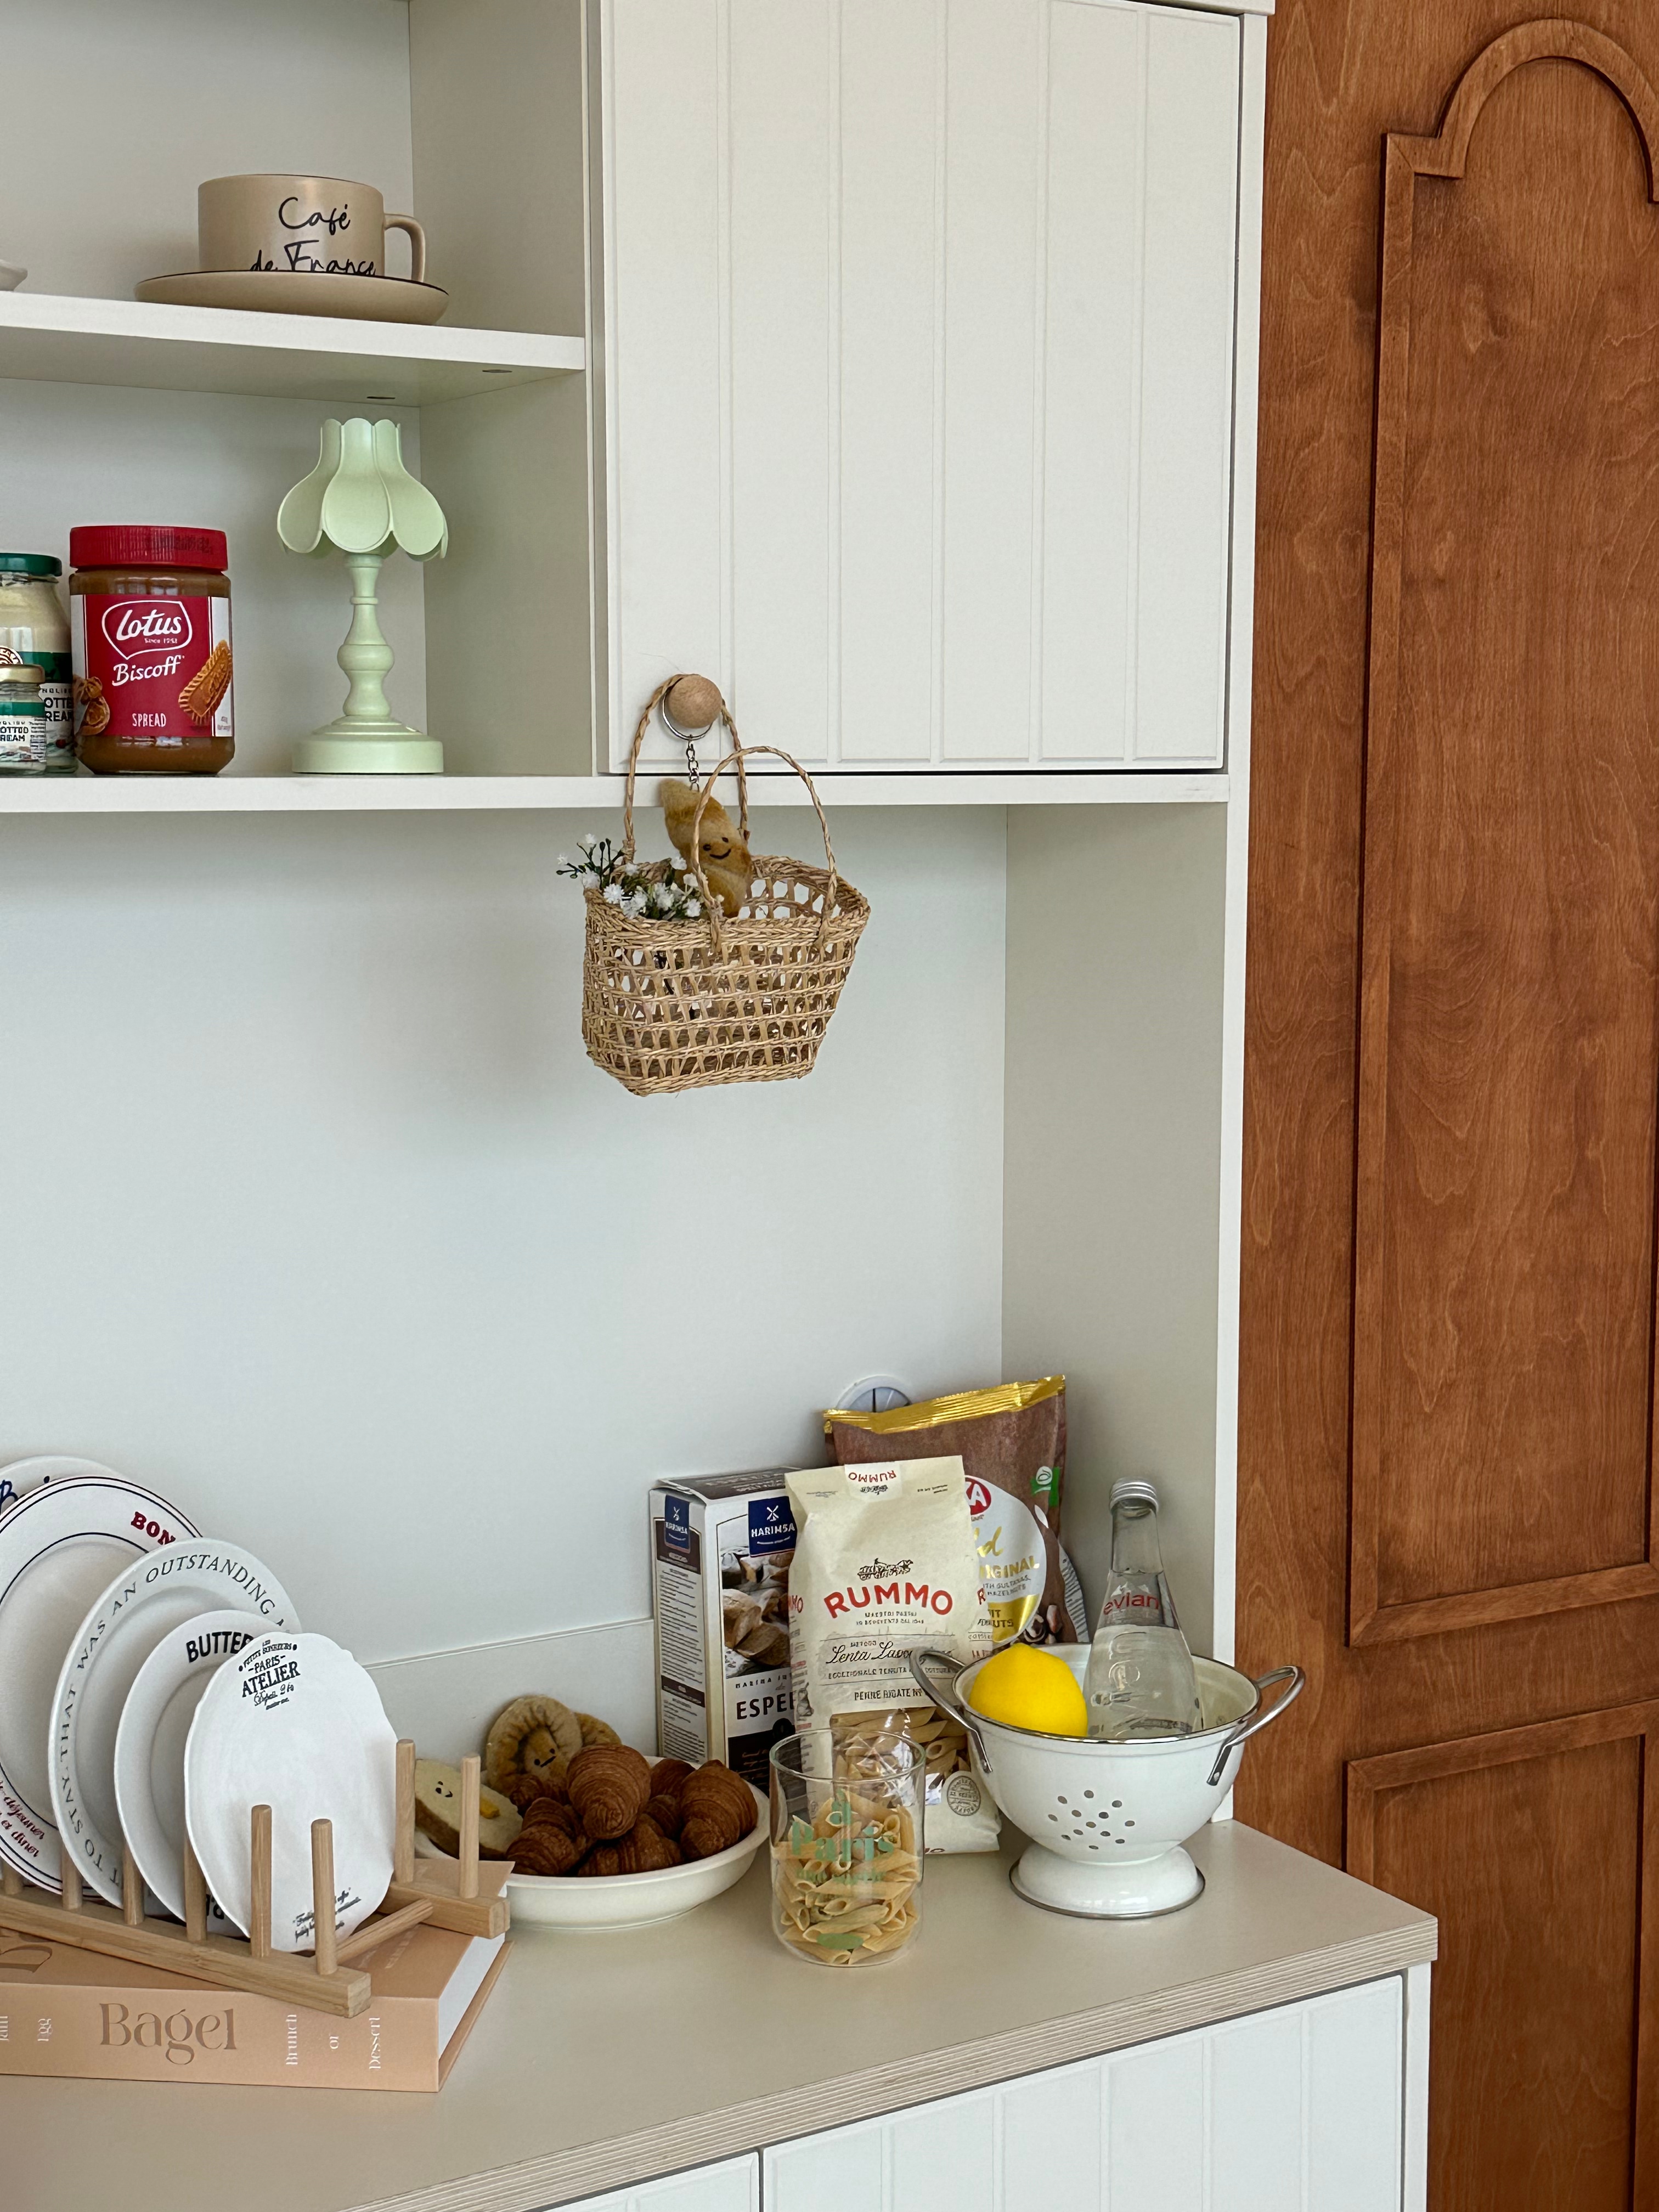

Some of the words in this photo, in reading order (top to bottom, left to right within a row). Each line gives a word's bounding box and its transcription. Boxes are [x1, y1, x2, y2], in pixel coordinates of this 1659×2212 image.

[278, 196, 351, 235] Café
[250, 249, 278, 272] de
[284, 239, 376, 276] France
[116, 609, 182, 641] Lotus
[111, 654, 182, 687] Biscoff
[44, 697, 74, 709] OTTE
[0, 726, 29, 734] OTTED
[132, 713, 167, 728] SPREAD
[848, 1470, 897, 1483] RUMMO
[130, 1511, 177, 1545] BON
[76, 1620, 106, 1669] WAS
[112, 1582, 137, 1616] AN
[145, 1554, 275, 1615] OUTSTANDING
[823, 1582, 953, 1618] RUMMO
[1103, 1592, 1159, 1616] evian
[242, 1661, 301, 1698] ATELIER
[736, 1692, 794, 1720] ESPE
[791, 1821, 894, 1862] Paris
[99, 2002, 237, 2065] Bagel
